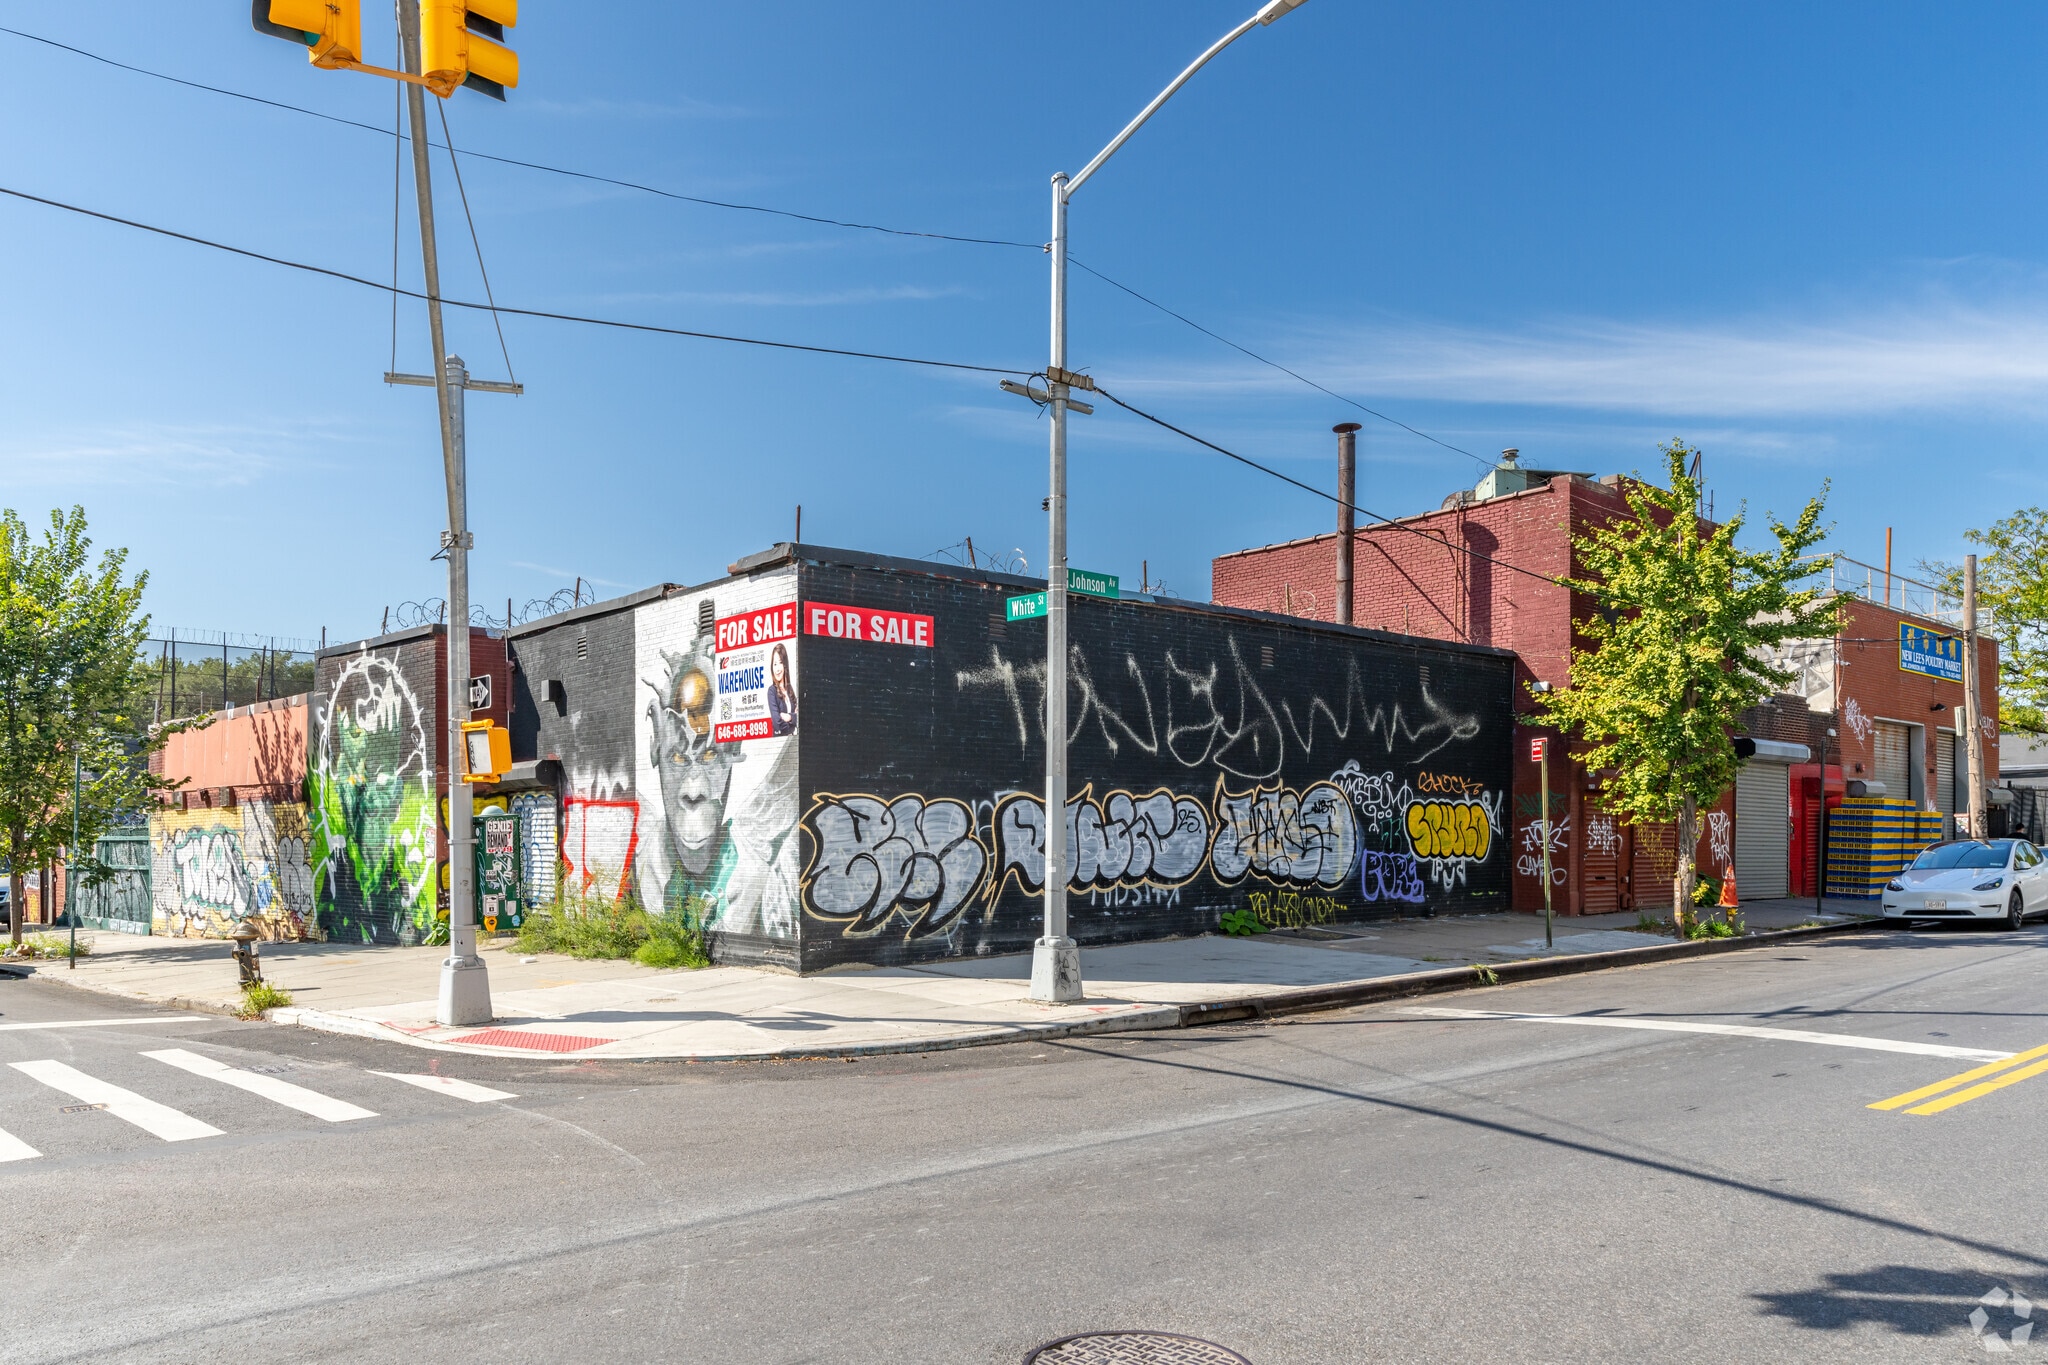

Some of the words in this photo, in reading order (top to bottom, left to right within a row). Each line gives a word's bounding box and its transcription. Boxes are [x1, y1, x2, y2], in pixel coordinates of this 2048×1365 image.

[1070, 572, 1105, 593] Johnson
[1011, 599, 1035, 616] White
[1038, 594, 1044, 605] St
[718, 619, 748, 649] FOR
[752, 608, 793, 642] SALE
[811, 608, 862, 640] FOR
[870, 615, 928, 646] SALE
[1902, 649, 1912, 662] NEW
[1945, 660, 1961, 672] MARKET
[717, 666, 765, 694] WAREHOUSE
[717, 721, 768, 740] 646-688-8998
[487, 820, 512, 832] GENIE
